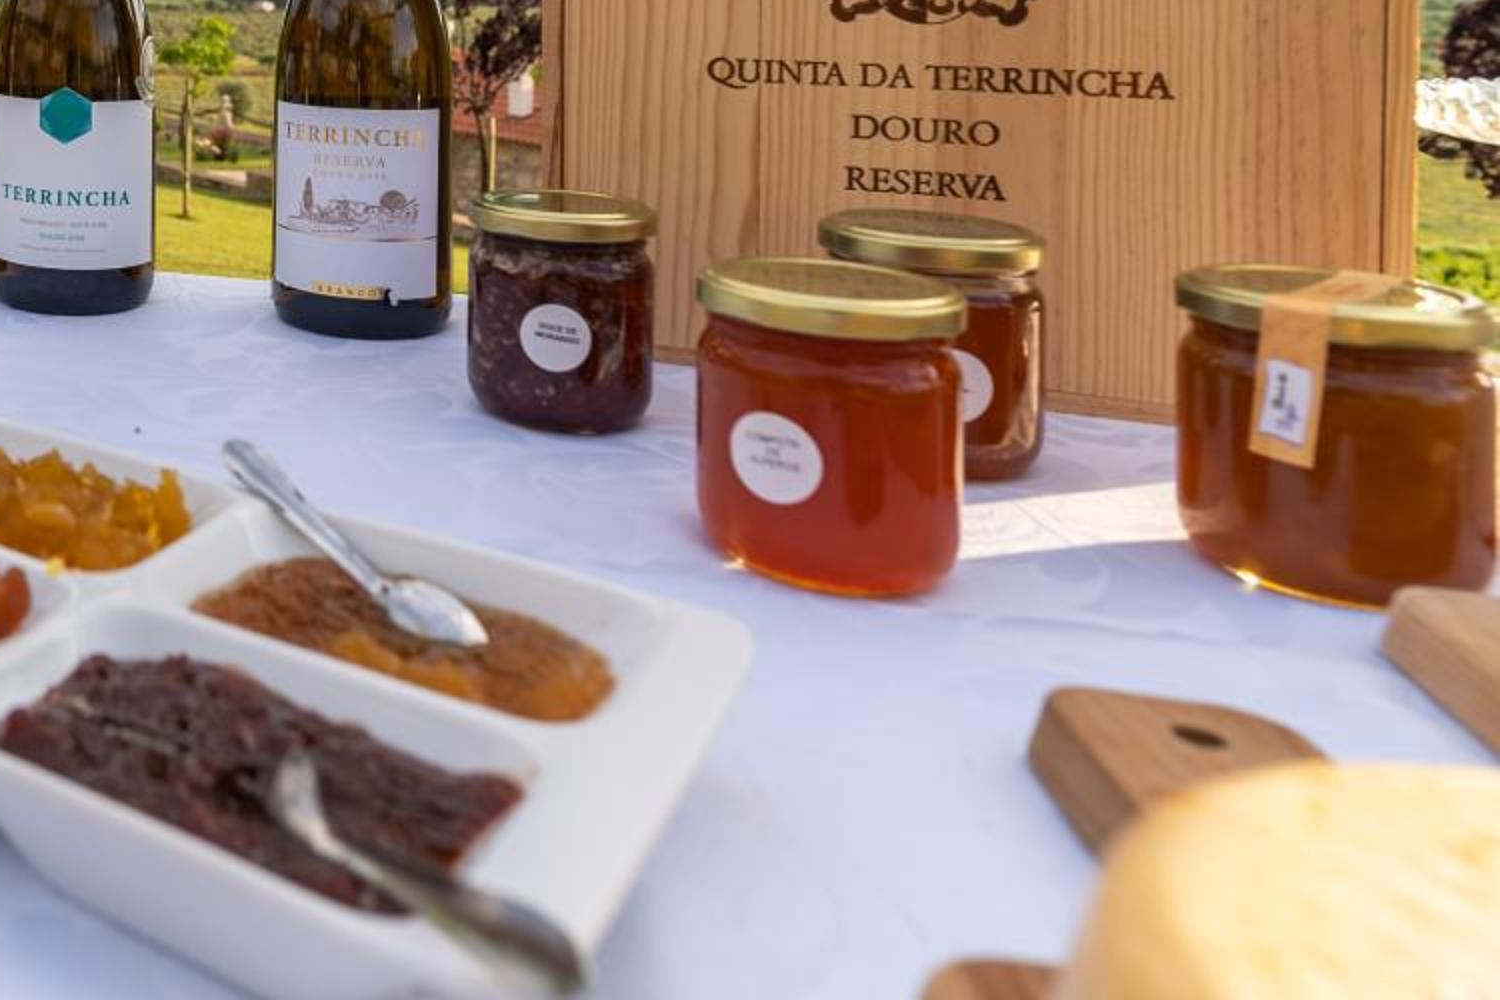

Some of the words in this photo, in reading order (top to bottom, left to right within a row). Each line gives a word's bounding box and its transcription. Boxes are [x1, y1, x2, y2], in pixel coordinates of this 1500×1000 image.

[706, 56, 848, 89] QUINTA
[859, 63, 915, 90] DA
[925, 64, 1176, 101] TERRINCHA
[850, 113, 1001, 148] DOURO
[1, 183, 132, 207] TERRINCHA
[844, 165, 1008, 202] RESERVA
